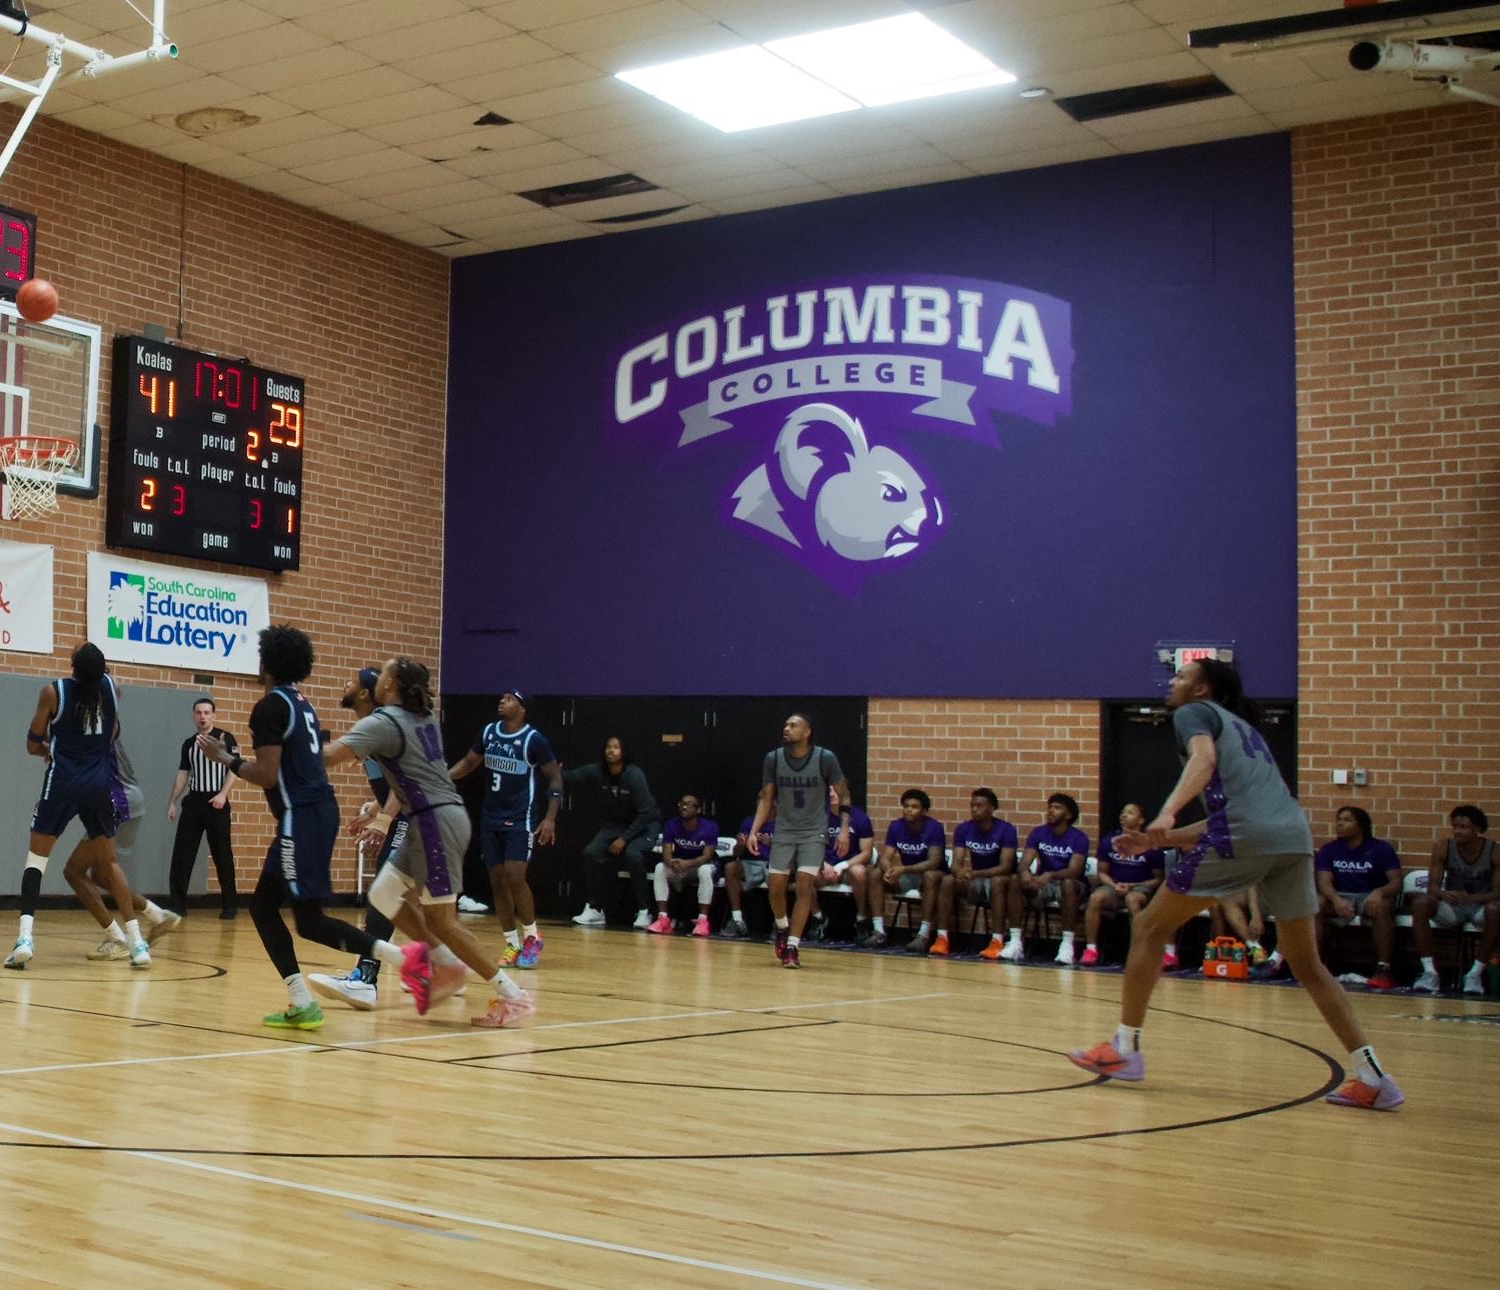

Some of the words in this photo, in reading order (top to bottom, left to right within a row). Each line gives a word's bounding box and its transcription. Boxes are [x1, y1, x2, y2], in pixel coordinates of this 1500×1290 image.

[137, 345, 172, 372] Koalas
[614, 284, 1060, 424] COLUMBIA
[195, 362, 258, 411] 17:01
[266, 378, 300, 403] Guests
[720, 362, 926, 402] COLLEGE
[139, 373, 175, 418] 41
[155, 426, 164, 439] B
[269, 404, 301, 448] 29
[202, 433, 236, 452] period
[246, 431, 259, 461] 2
[271, 452, 279, 463] B
[133, 449, 159, 469] fouls
[201, 462, 234, 484] player
[274, 477, 297, 496] fouls
[141, 479, 155, 511] 2
[173, 485, 186, 516] 3
[251, 500, 263, 529] 3
[286, 508, 293, 534] 1
[133, 521, 153, 537] won
[202, 532, 229, 549] game
[274, 545, 291, 560] won
[148, 577, 184, 595] South
[186, 582, 236, 602] Carolina
[146, 592, 247, 627] Education
[146, 615, 236, 657] Lottery
[303, 711, 320, 755] 5
[491, 772, 501, 792] 3
[896, 841, 928, 852] KOALA
[965, 840, 1001, 851] KOALA
[1037, 842, 1074, 854] KOALA
[1332, 859, 1373, 869] KOALA
[1215, 964, 1228, 976] G
